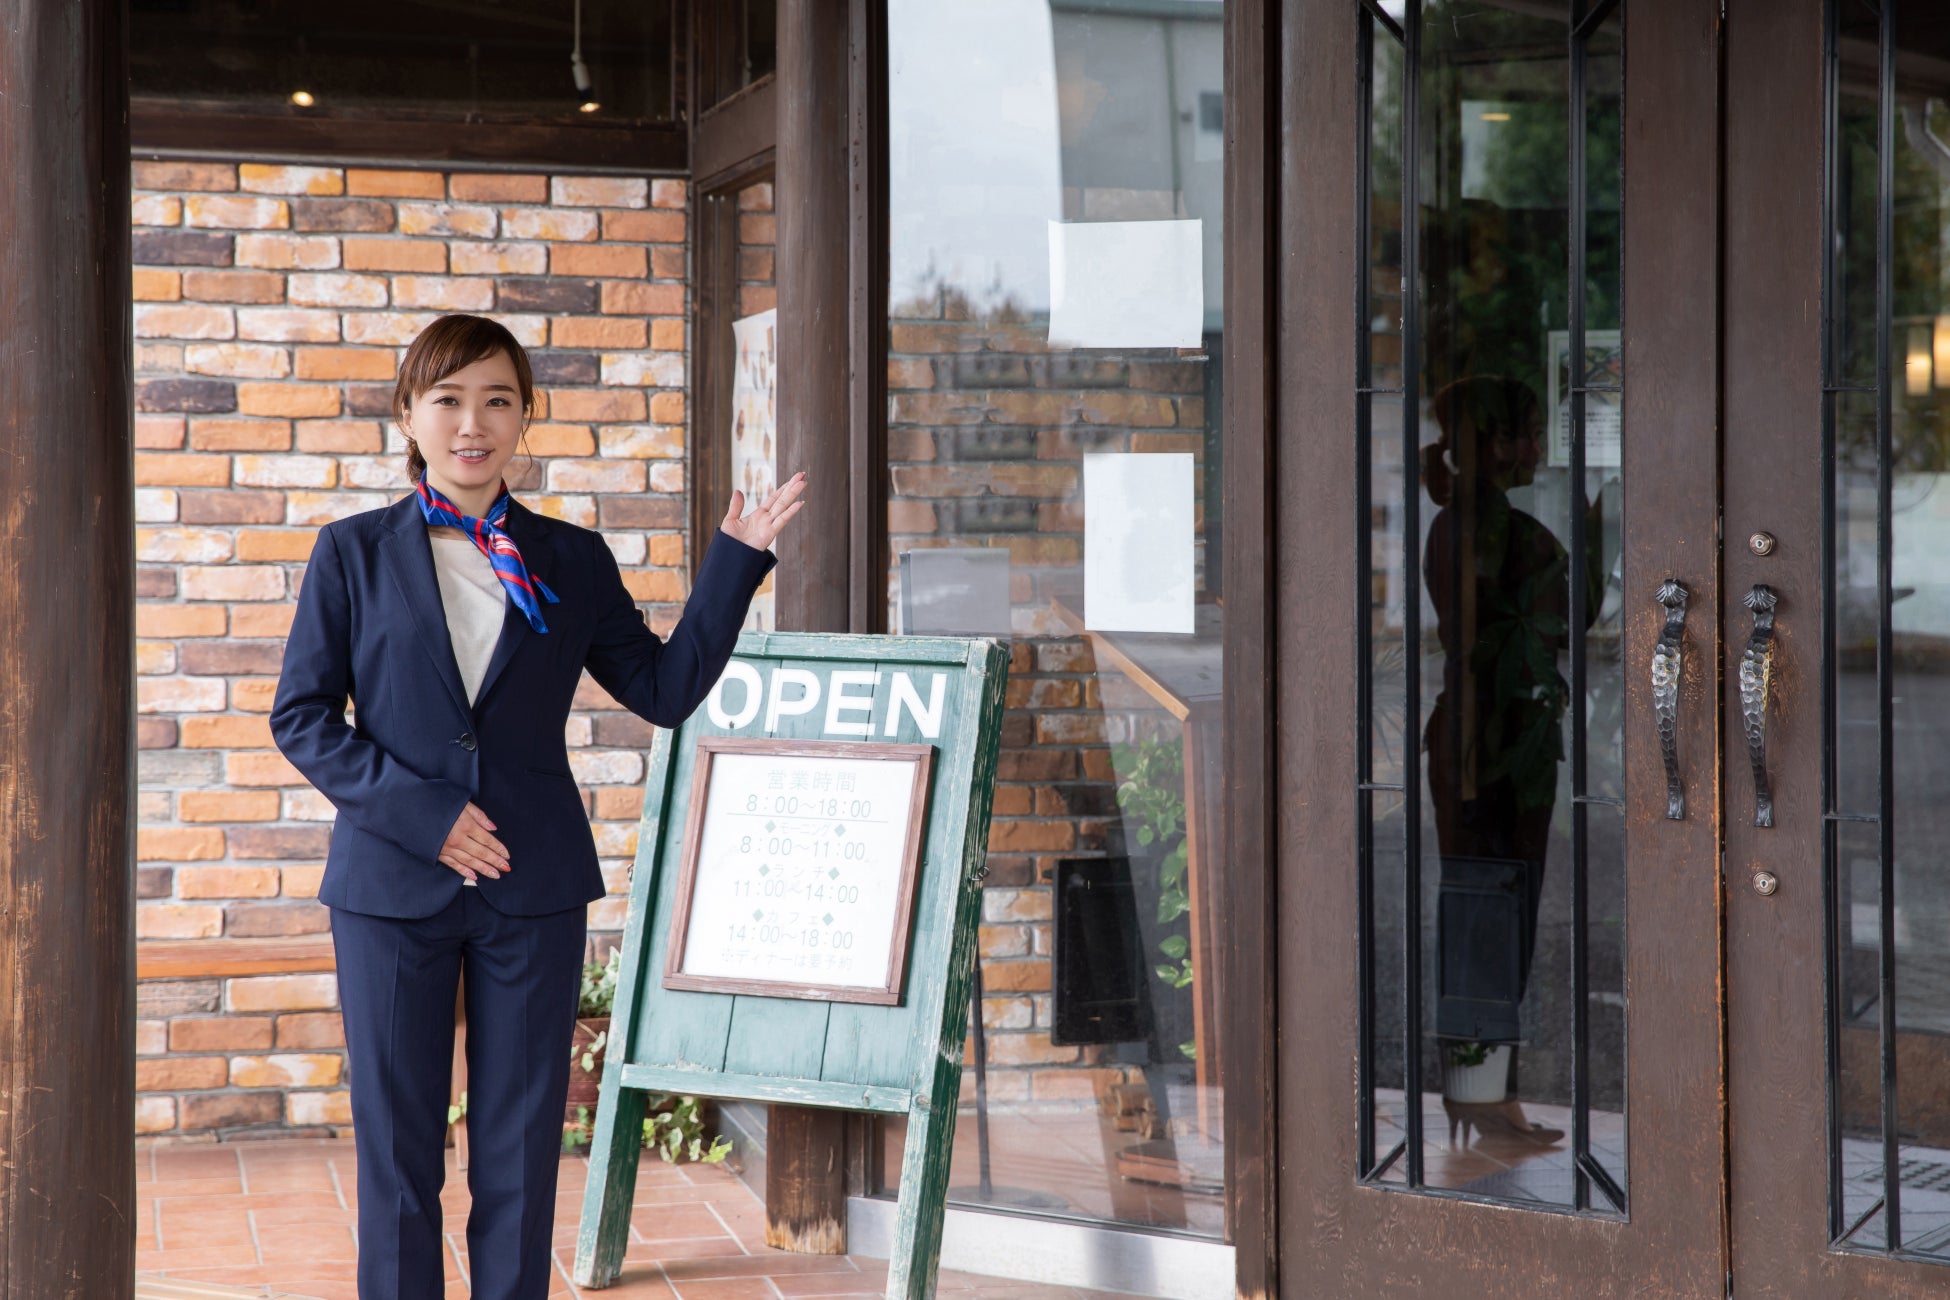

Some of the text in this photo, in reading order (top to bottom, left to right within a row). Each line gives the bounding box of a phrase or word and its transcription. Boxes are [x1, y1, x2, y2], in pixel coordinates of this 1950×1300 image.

[706, 660, 947, 739] OPEN
[767, 769, 857, 793] 営業時間
[779, 822, 832, 838] モーニング
[773, 864, 825, 878] ランチ
[767, 910, 820, 926] カフェ
